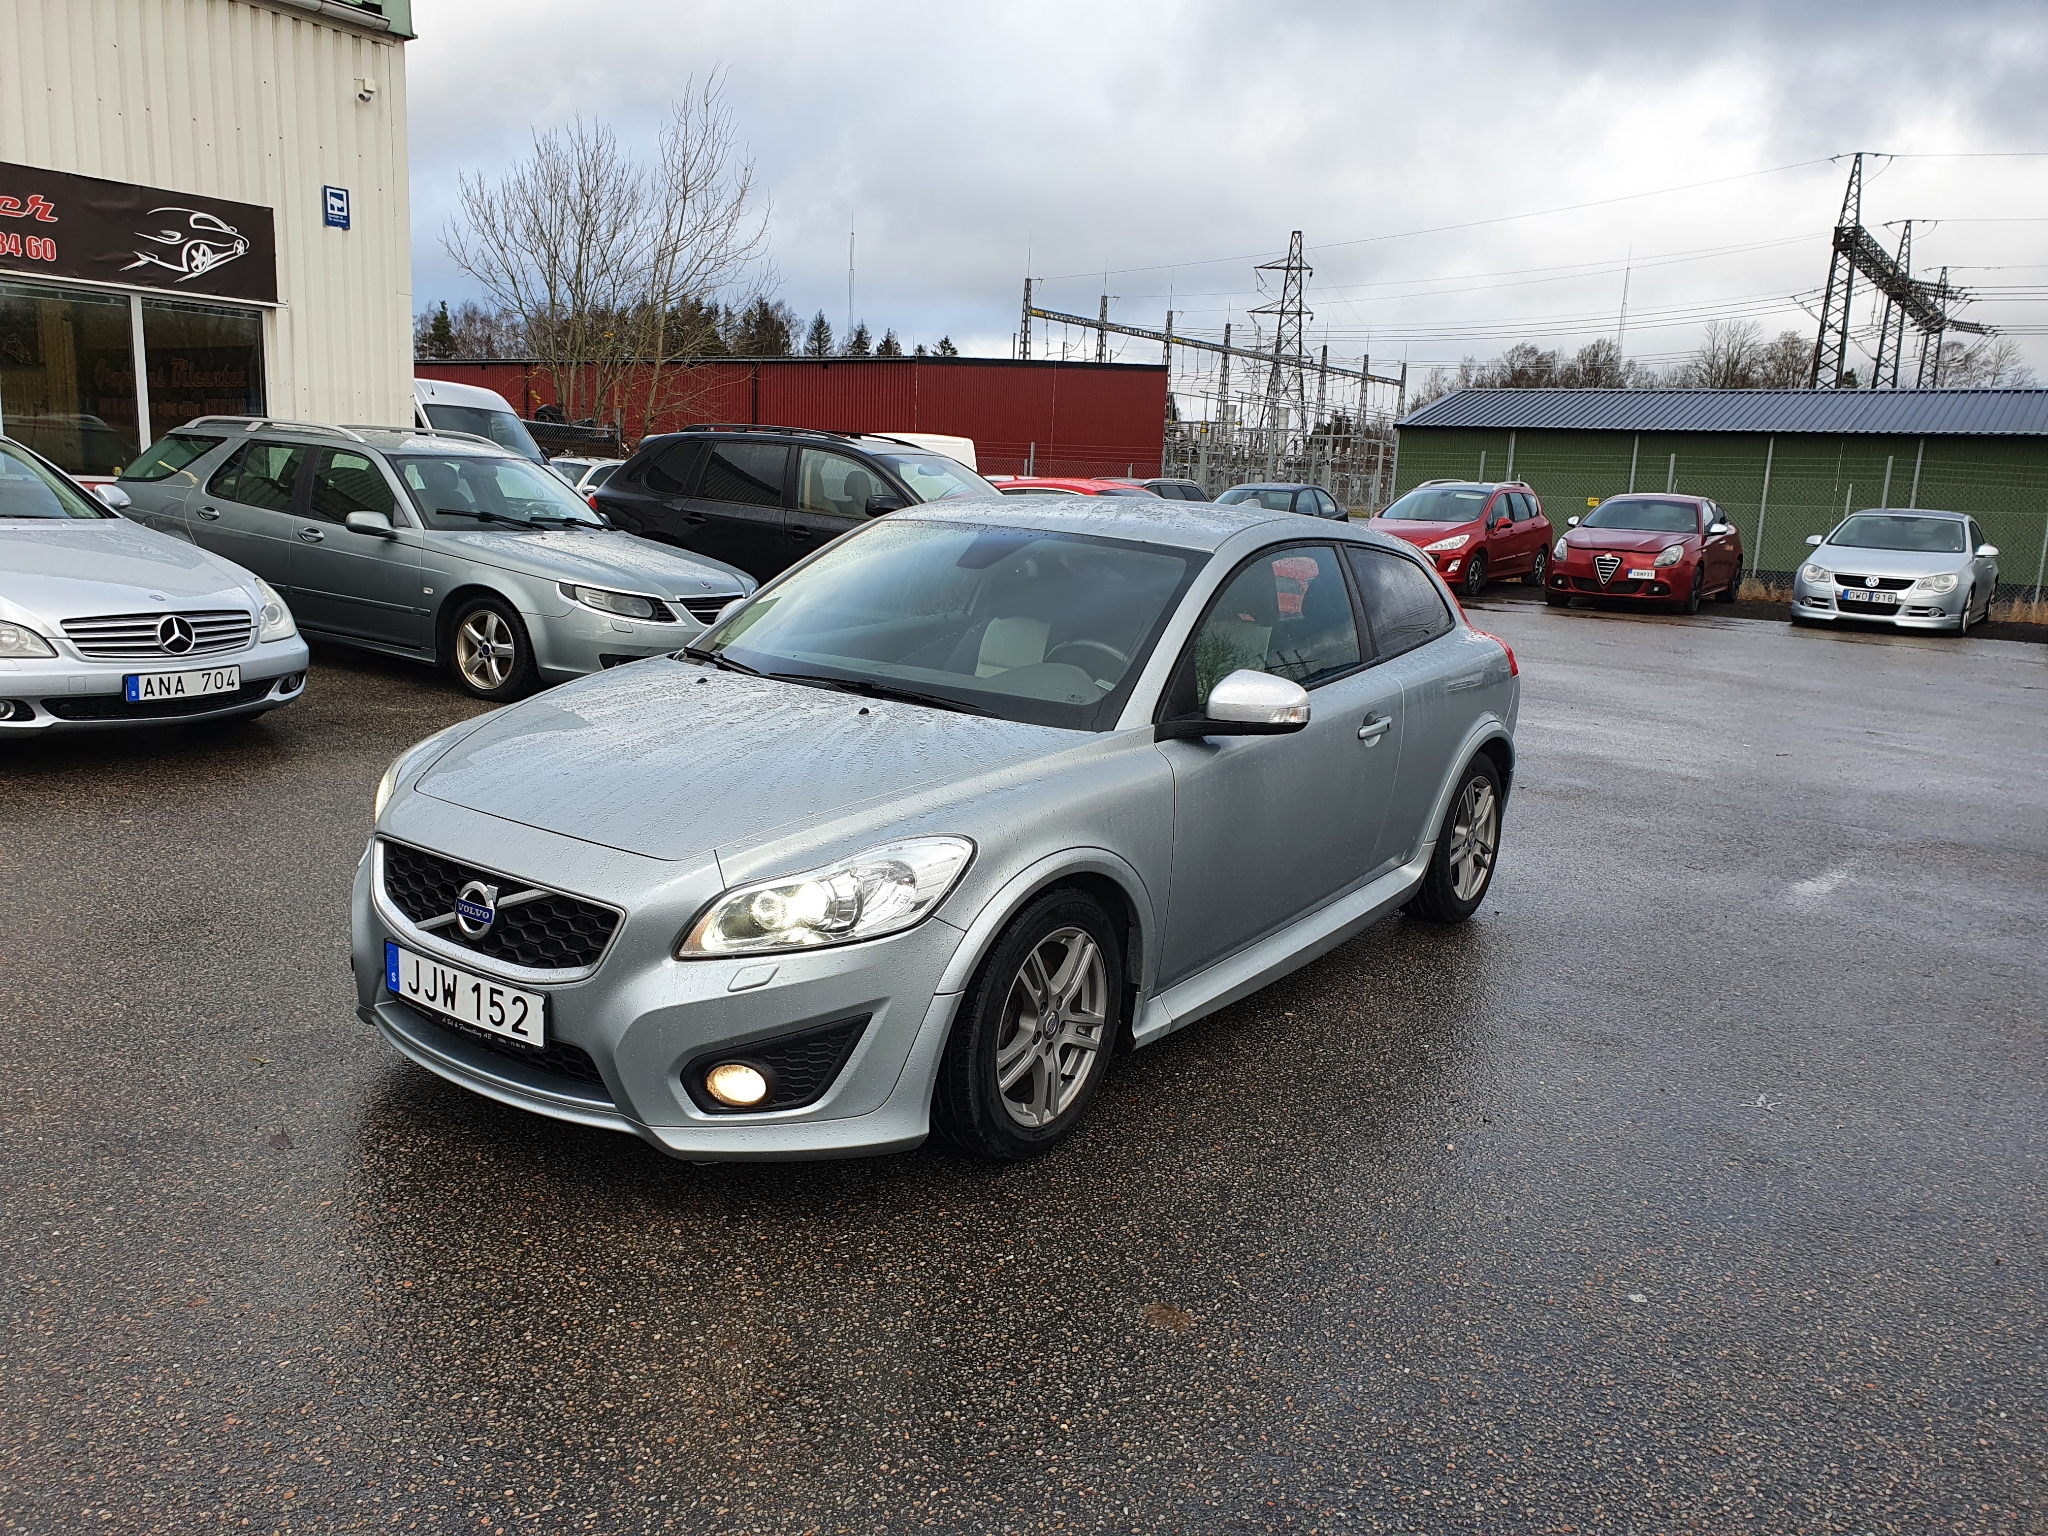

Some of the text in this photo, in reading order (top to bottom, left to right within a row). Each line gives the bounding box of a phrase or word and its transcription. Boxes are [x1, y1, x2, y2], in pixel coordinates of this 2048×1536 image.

[26, 235, 57, 262] 60
[1874, 593, 1894, 603] 918
[144, 669, 236, 697] ANA 704
[457, 901, 490, 920] VOLVO
[391, 971, 397, 983] S
[408, 959, 529, 1037] JJW 152
